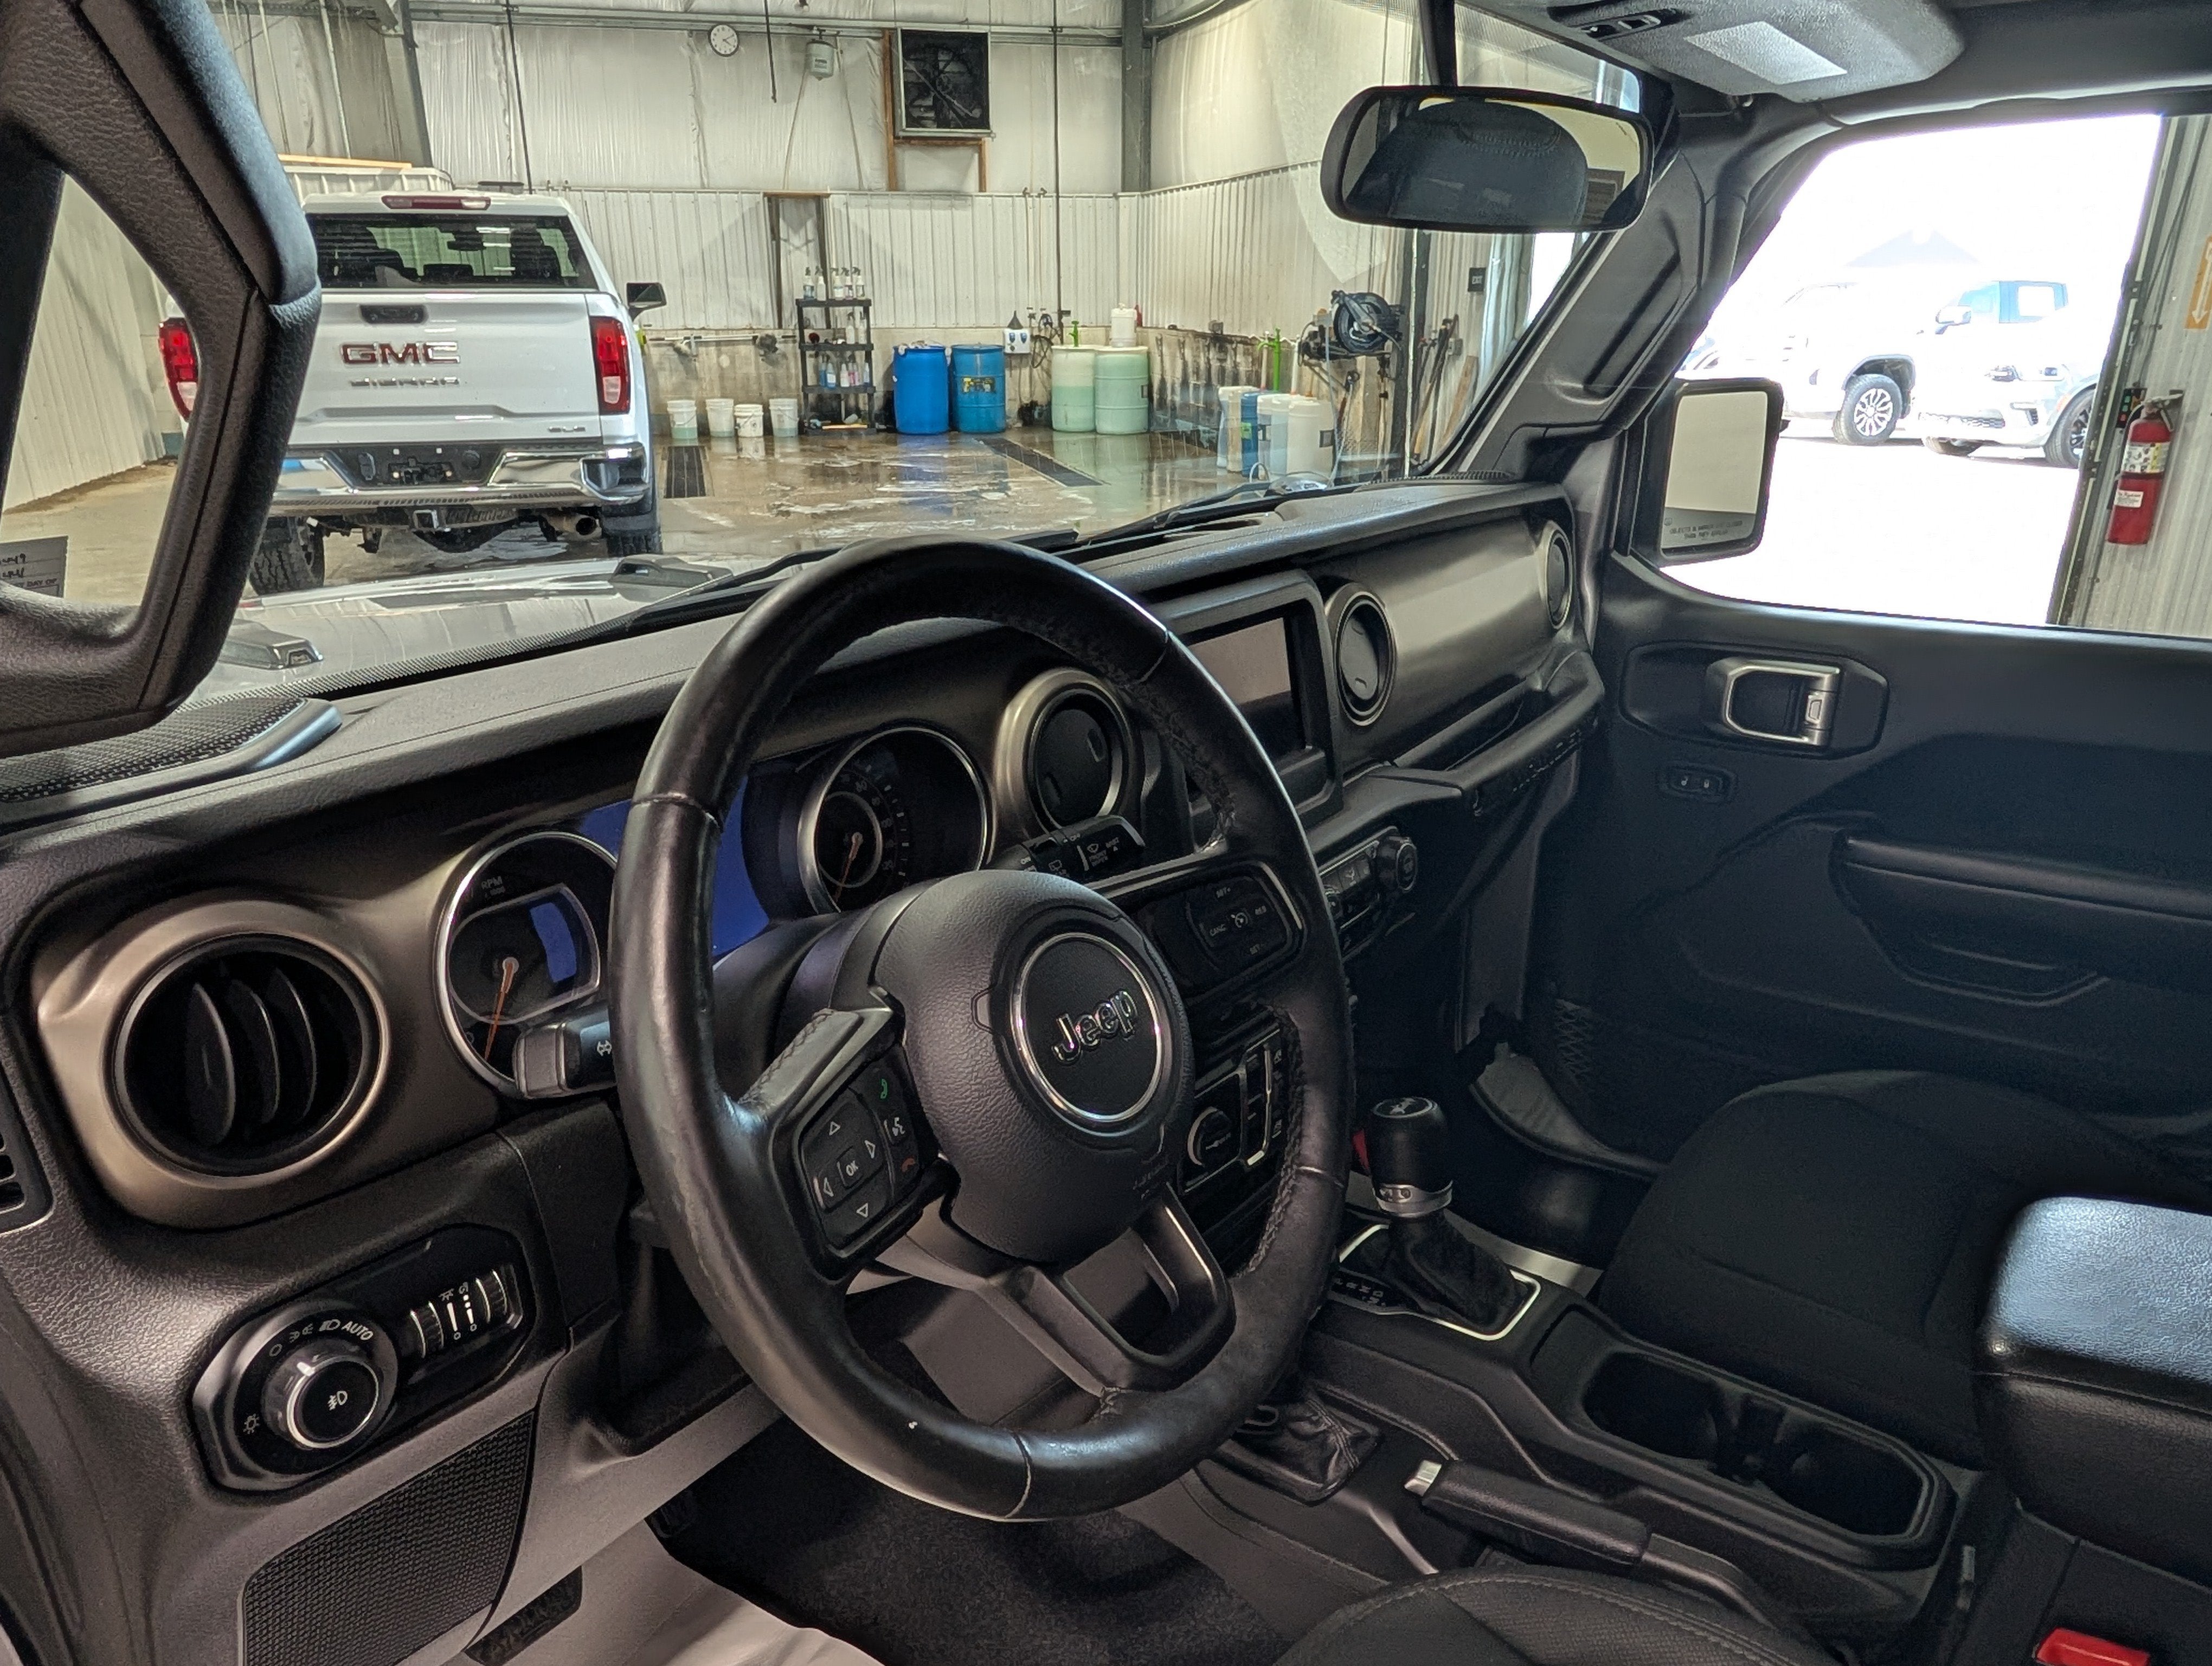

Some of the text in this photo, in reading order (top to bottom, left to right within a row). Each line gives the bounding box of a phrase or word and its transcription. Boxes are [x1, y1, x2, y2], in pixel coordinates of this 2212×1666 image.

[341, 342, 461, 366] GMC
[1052, 990, 1138, 1063] Jeep
[846, 1161, 859, 1176] OK
[341, 1321, 374, 1341] AUTO
